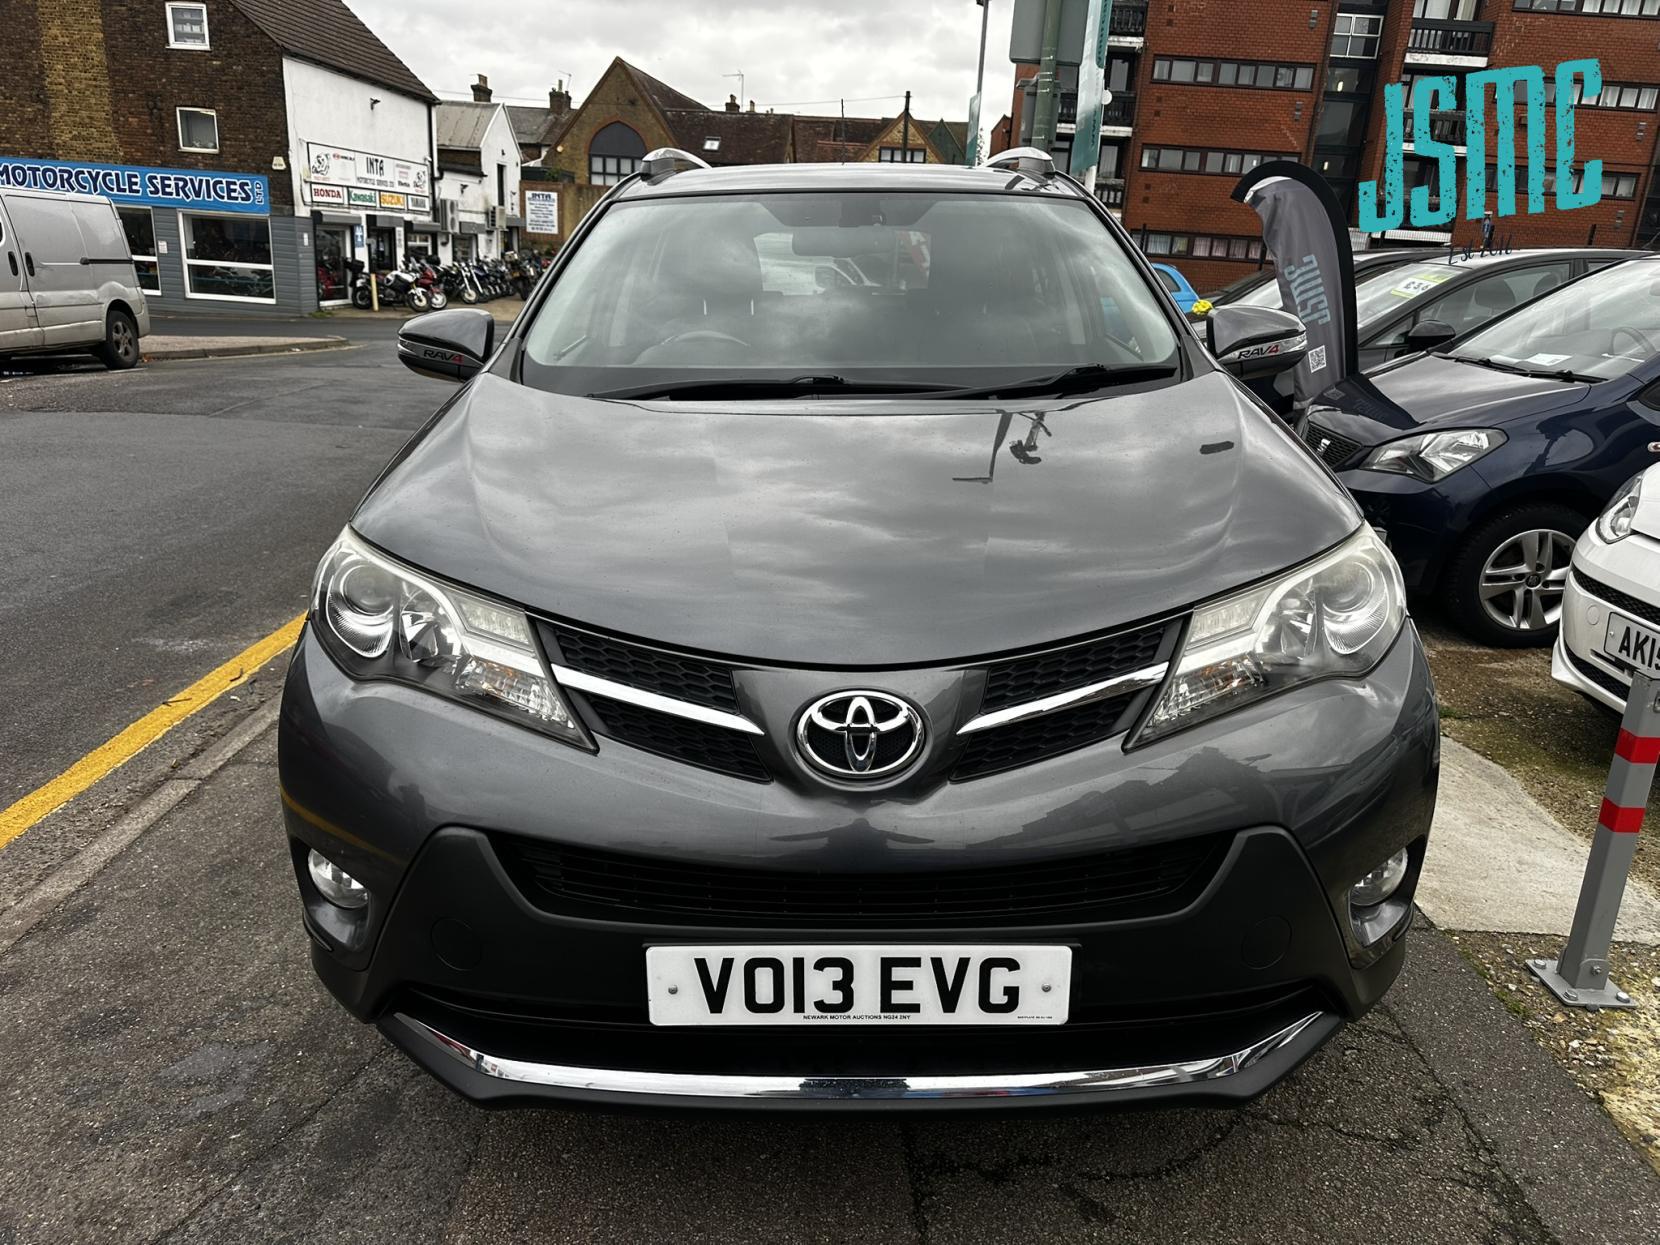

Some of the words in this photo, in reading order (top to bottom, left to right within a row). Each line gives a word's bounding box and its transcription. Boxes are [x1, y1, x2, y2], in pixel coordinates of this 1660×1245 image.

[365, 157, 385, 177] INTA
[0, 163, 141, 195] MOTORCYCLE
[146, 172, 254, 204] SERVICES
[254, 181, 264, 205] LTD
[313, 188, 342, 199] HONDA
[348, 189, 377, 204] Kawasaki
[381, 193, 405, 206] SUZUKI
[1284, 253, 1331, 326] JSMC
[423, 350, 464, 364] RAV4
[1237, 344, 1281, 360] RAV4
[880, 957, 1021, 1014] EVG
